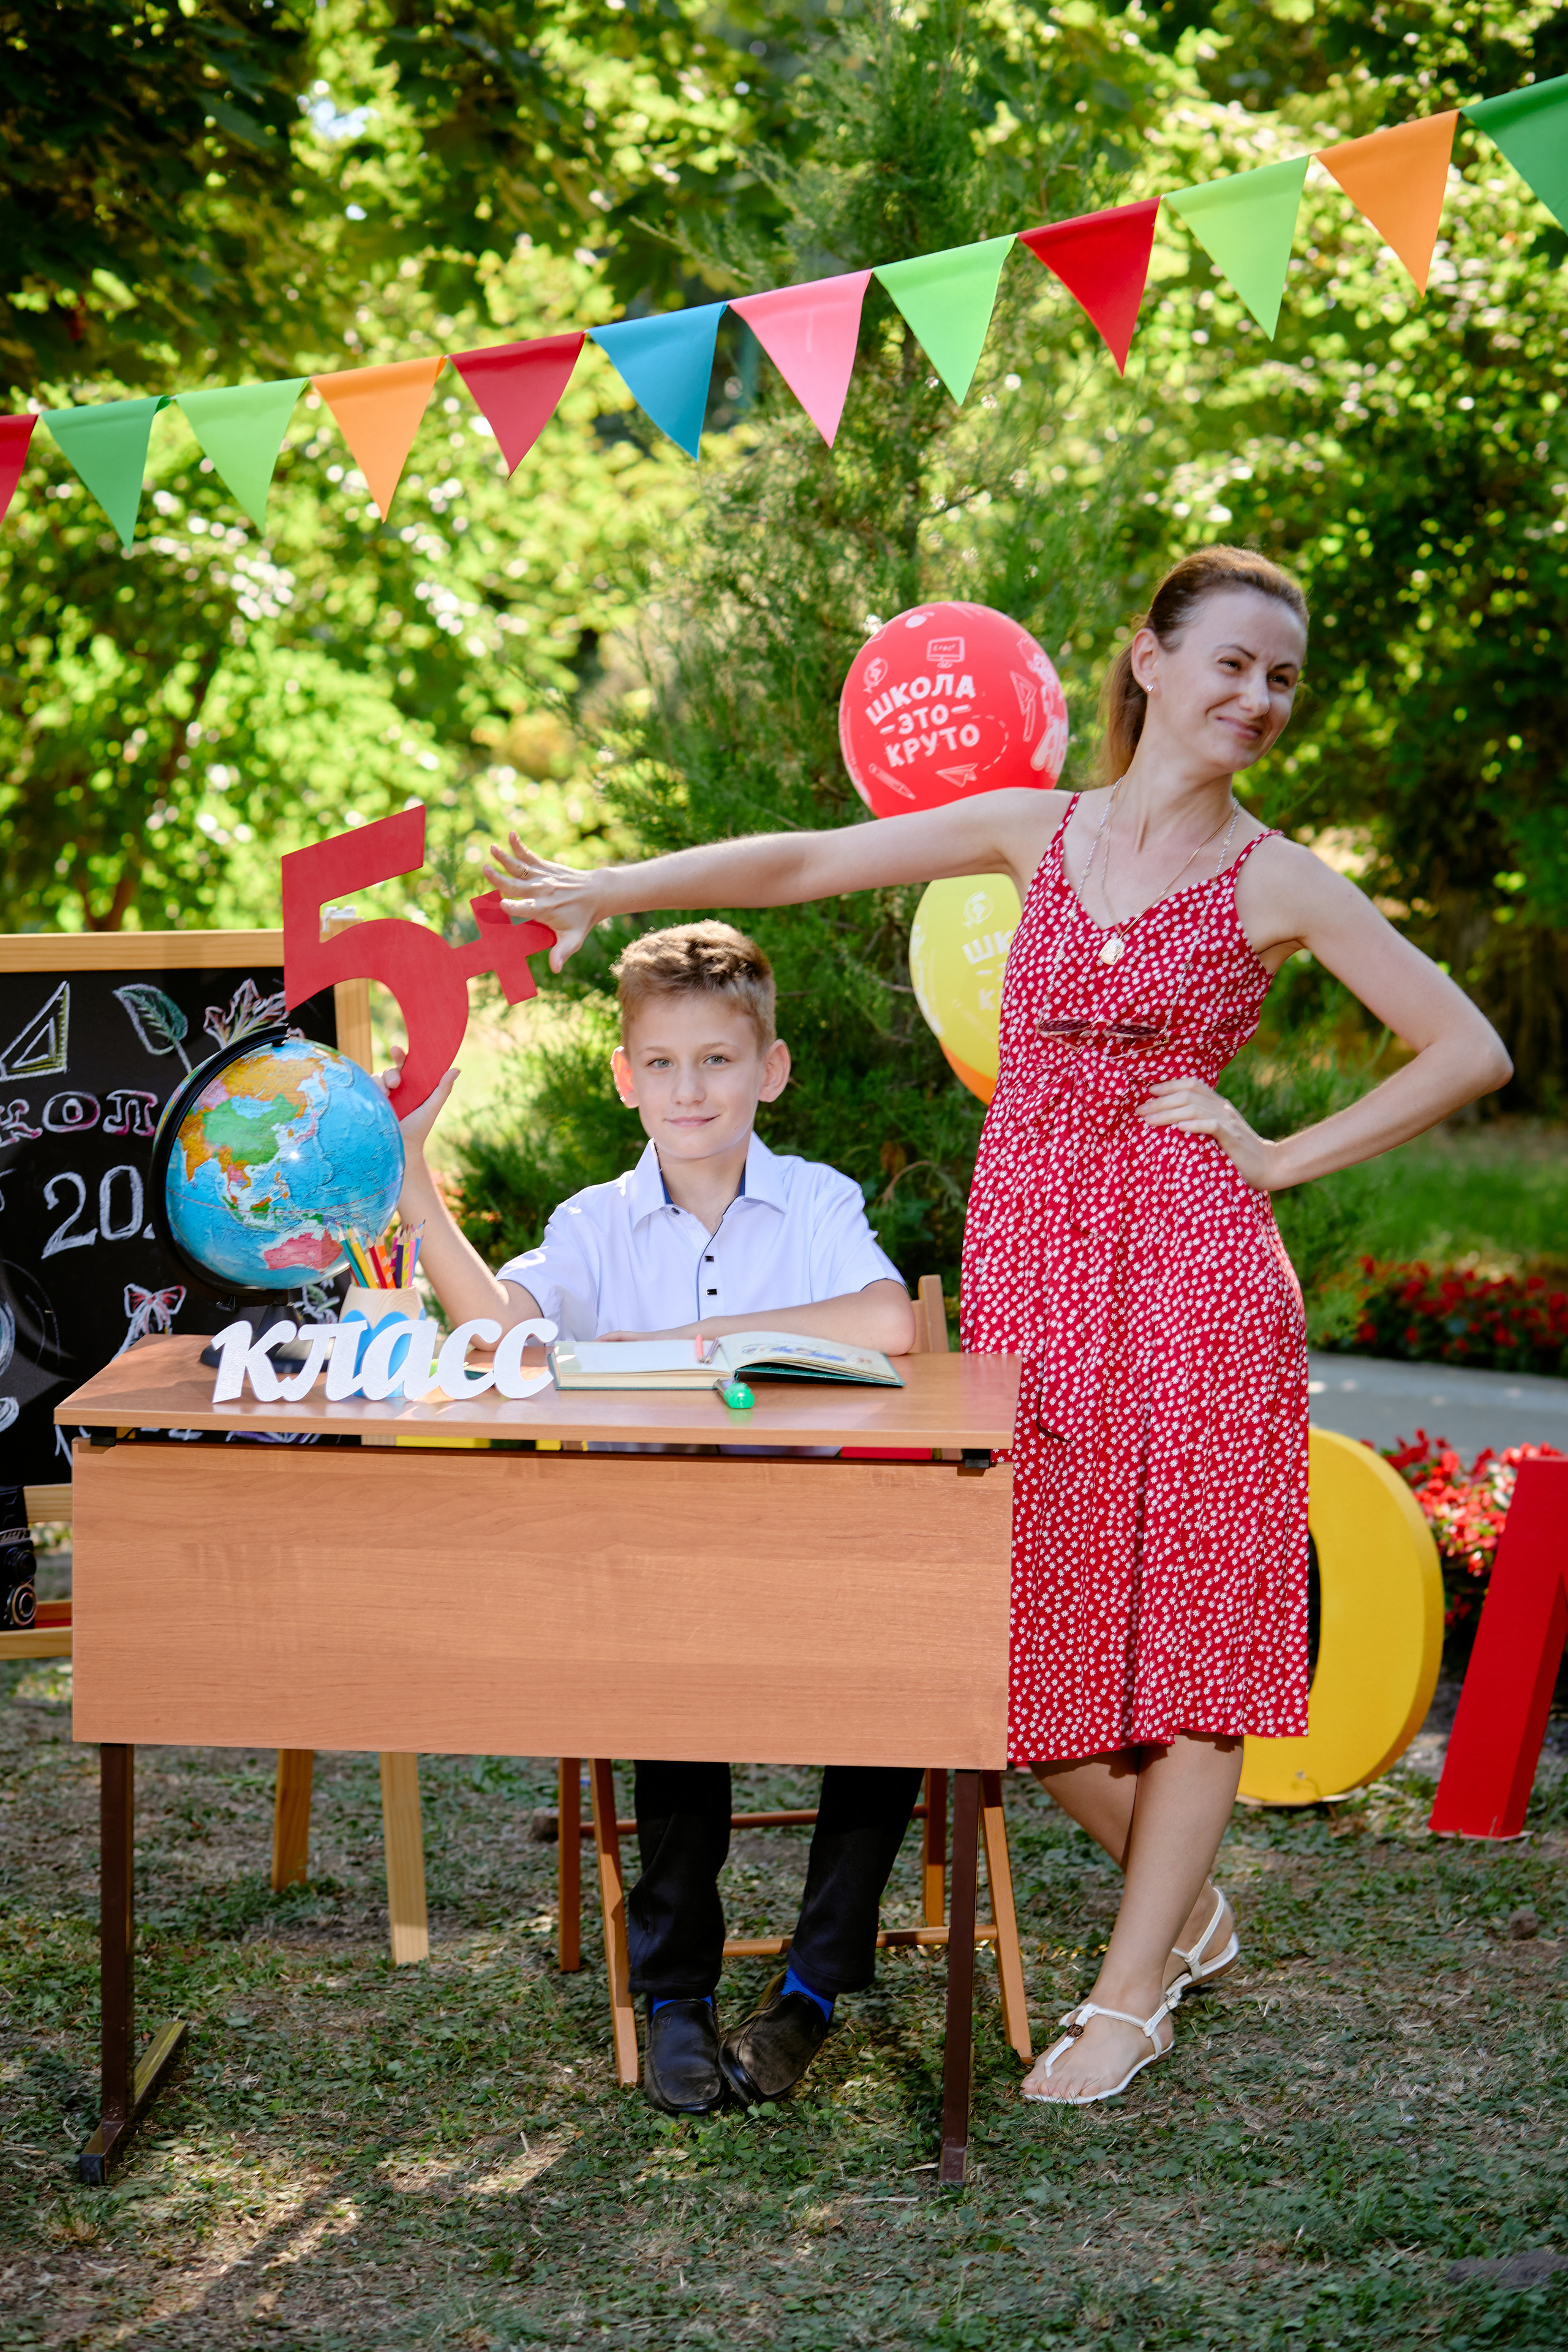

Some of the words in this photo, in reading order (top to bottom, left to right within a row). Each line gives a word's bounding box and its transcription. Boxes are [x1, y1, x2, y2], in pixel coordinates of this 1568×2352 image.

[864, 673, 977, 726] ШКОЛА
[884, 723, 980, 768] КРУТО
[40, 1165, 156, 1260] 20
[210, 1318, 558, 1403] класс
